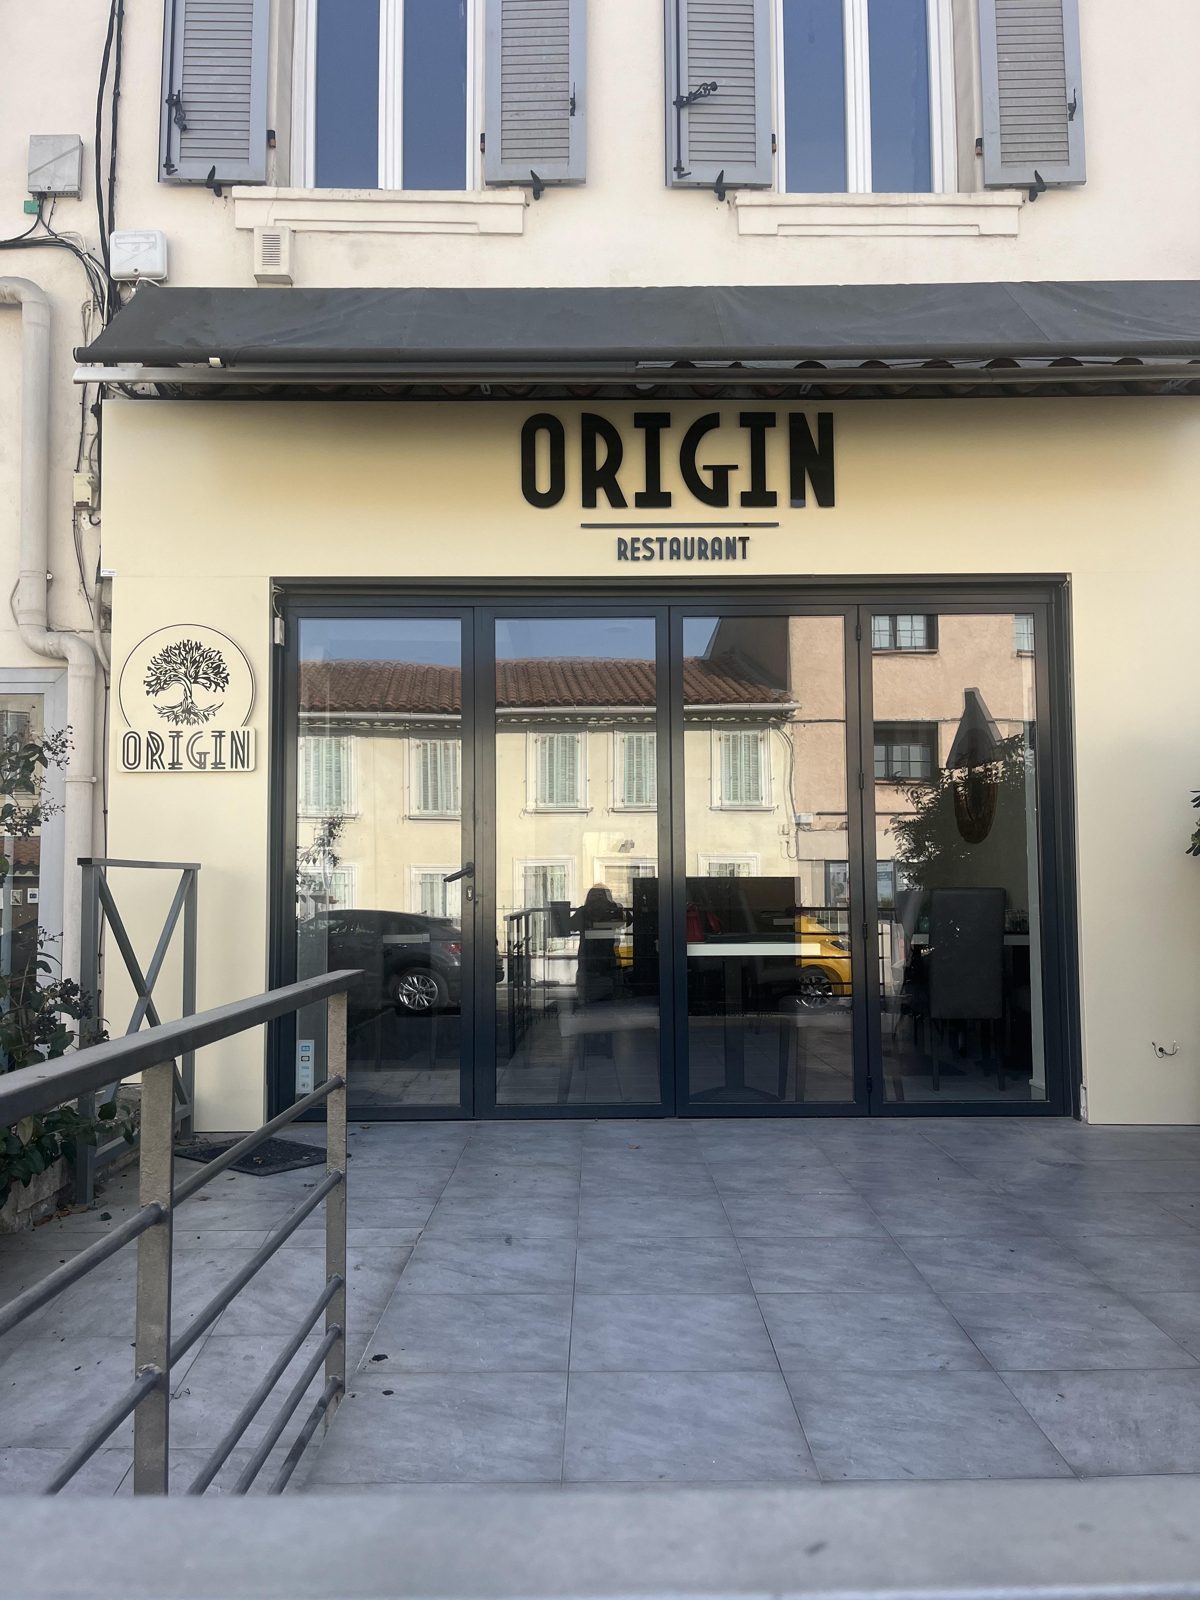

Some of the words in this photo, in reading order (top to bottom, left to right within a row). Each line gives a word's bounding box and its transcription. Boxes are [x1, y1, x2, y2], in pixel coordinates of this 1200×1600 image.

[521, 412, 835, 508] ORIGIN
[617, 536, 750, 561] RESTAURANT
[122, 730, 250, 770] ORIGIN
